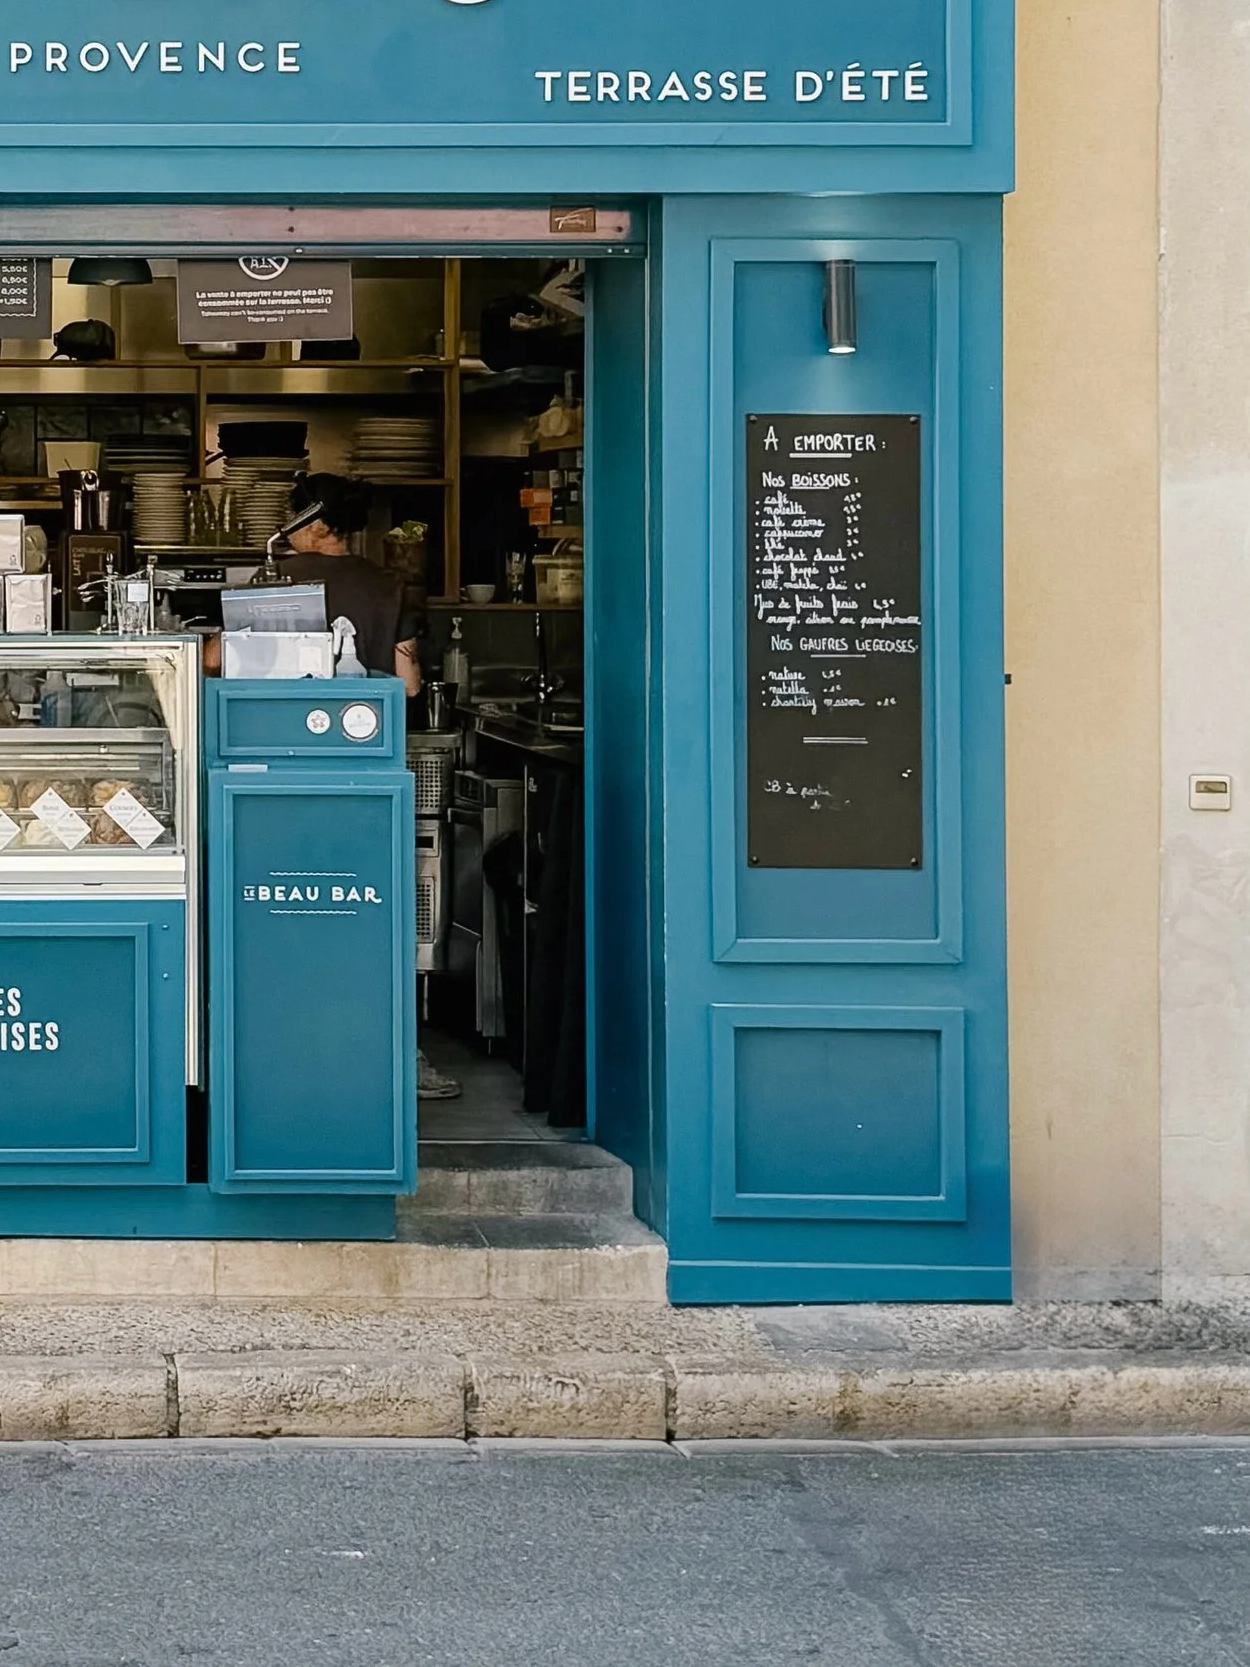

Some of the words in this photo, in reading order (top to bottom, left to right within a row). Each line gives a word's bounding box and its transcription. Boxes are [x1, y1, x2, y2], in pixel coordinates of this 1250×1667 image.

[9, 40, 304, 73] PROVENCE
[534, 70, 767, 102] TERRASSE
[795, 62, 929, 102] D'ÉTÉ
[763, 425, 779, 451] A
[762, 472, 785, 488] Nos
[800, 637, 848, 651] GAUFRES
[258, 885, 319, 902] BEAU
[331, 886, 382, 904] BAR
